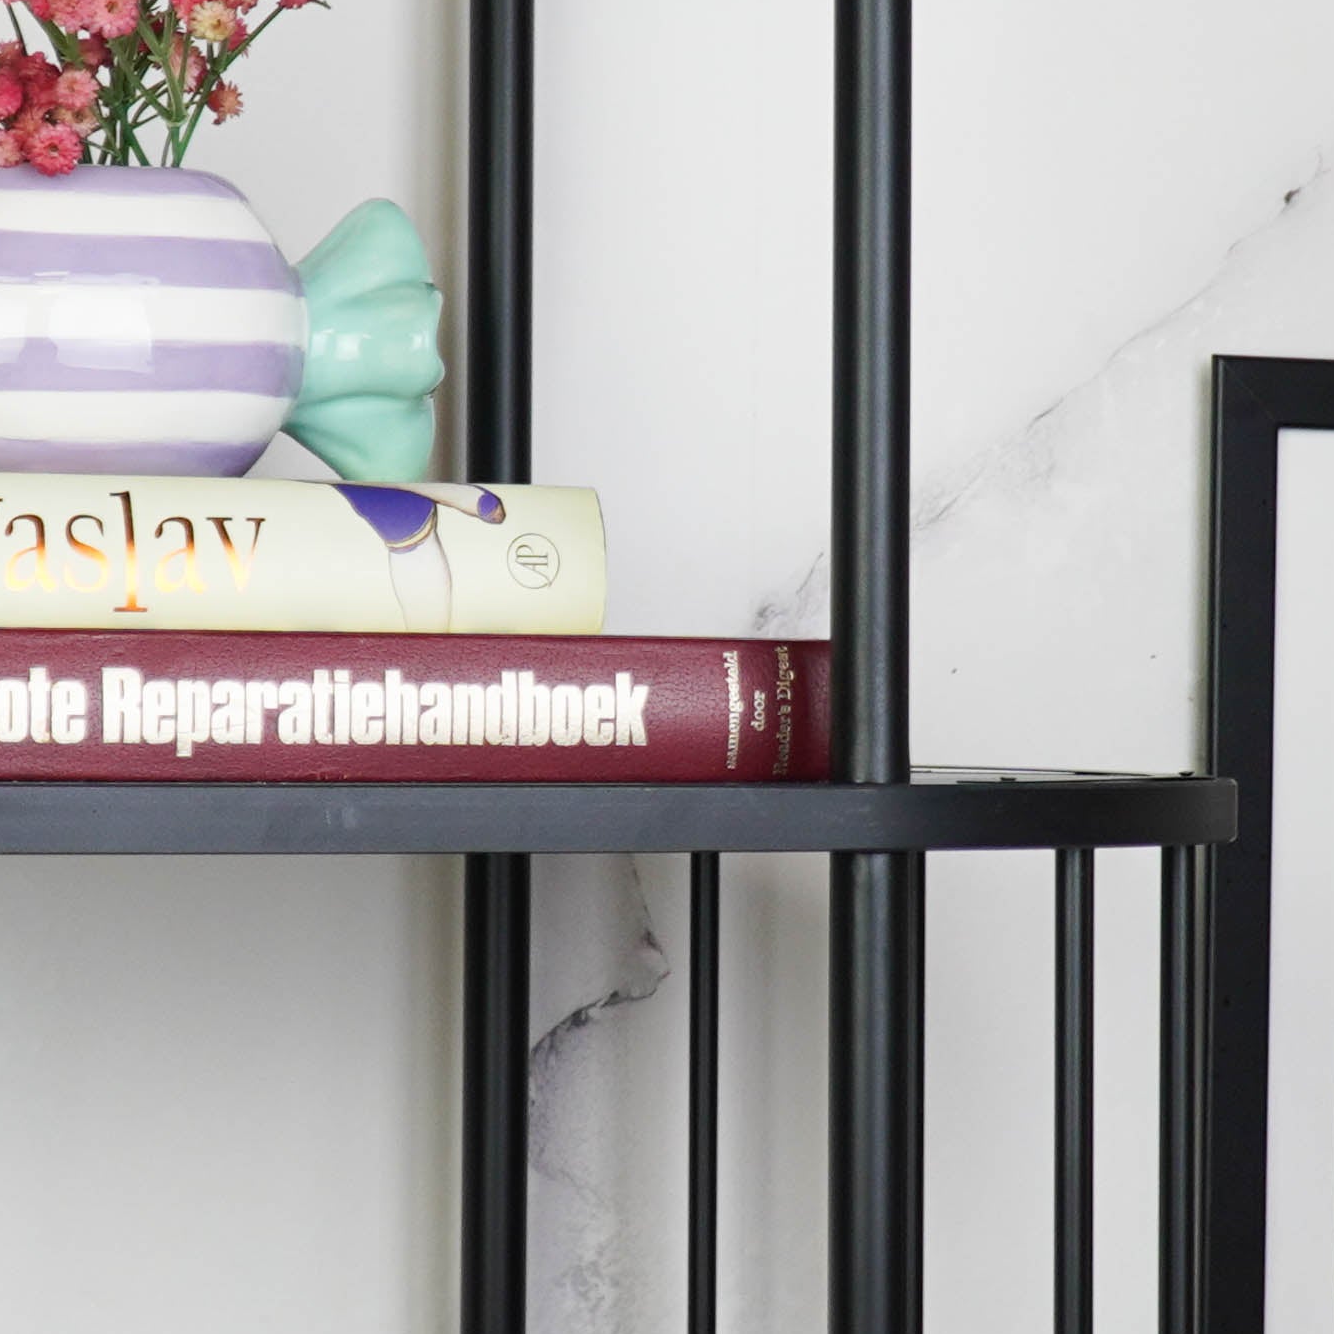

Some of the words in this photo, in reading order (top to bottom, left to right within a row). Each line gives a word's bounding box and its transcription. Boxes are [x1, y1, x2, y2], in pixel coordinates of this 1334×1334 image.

[774, 645, 795, 700] Digest
[101, 666, 650, 757] Reparatiehandboek
[750, 690, 766, 731] door
[772, 704, 791, 775] Reader's
